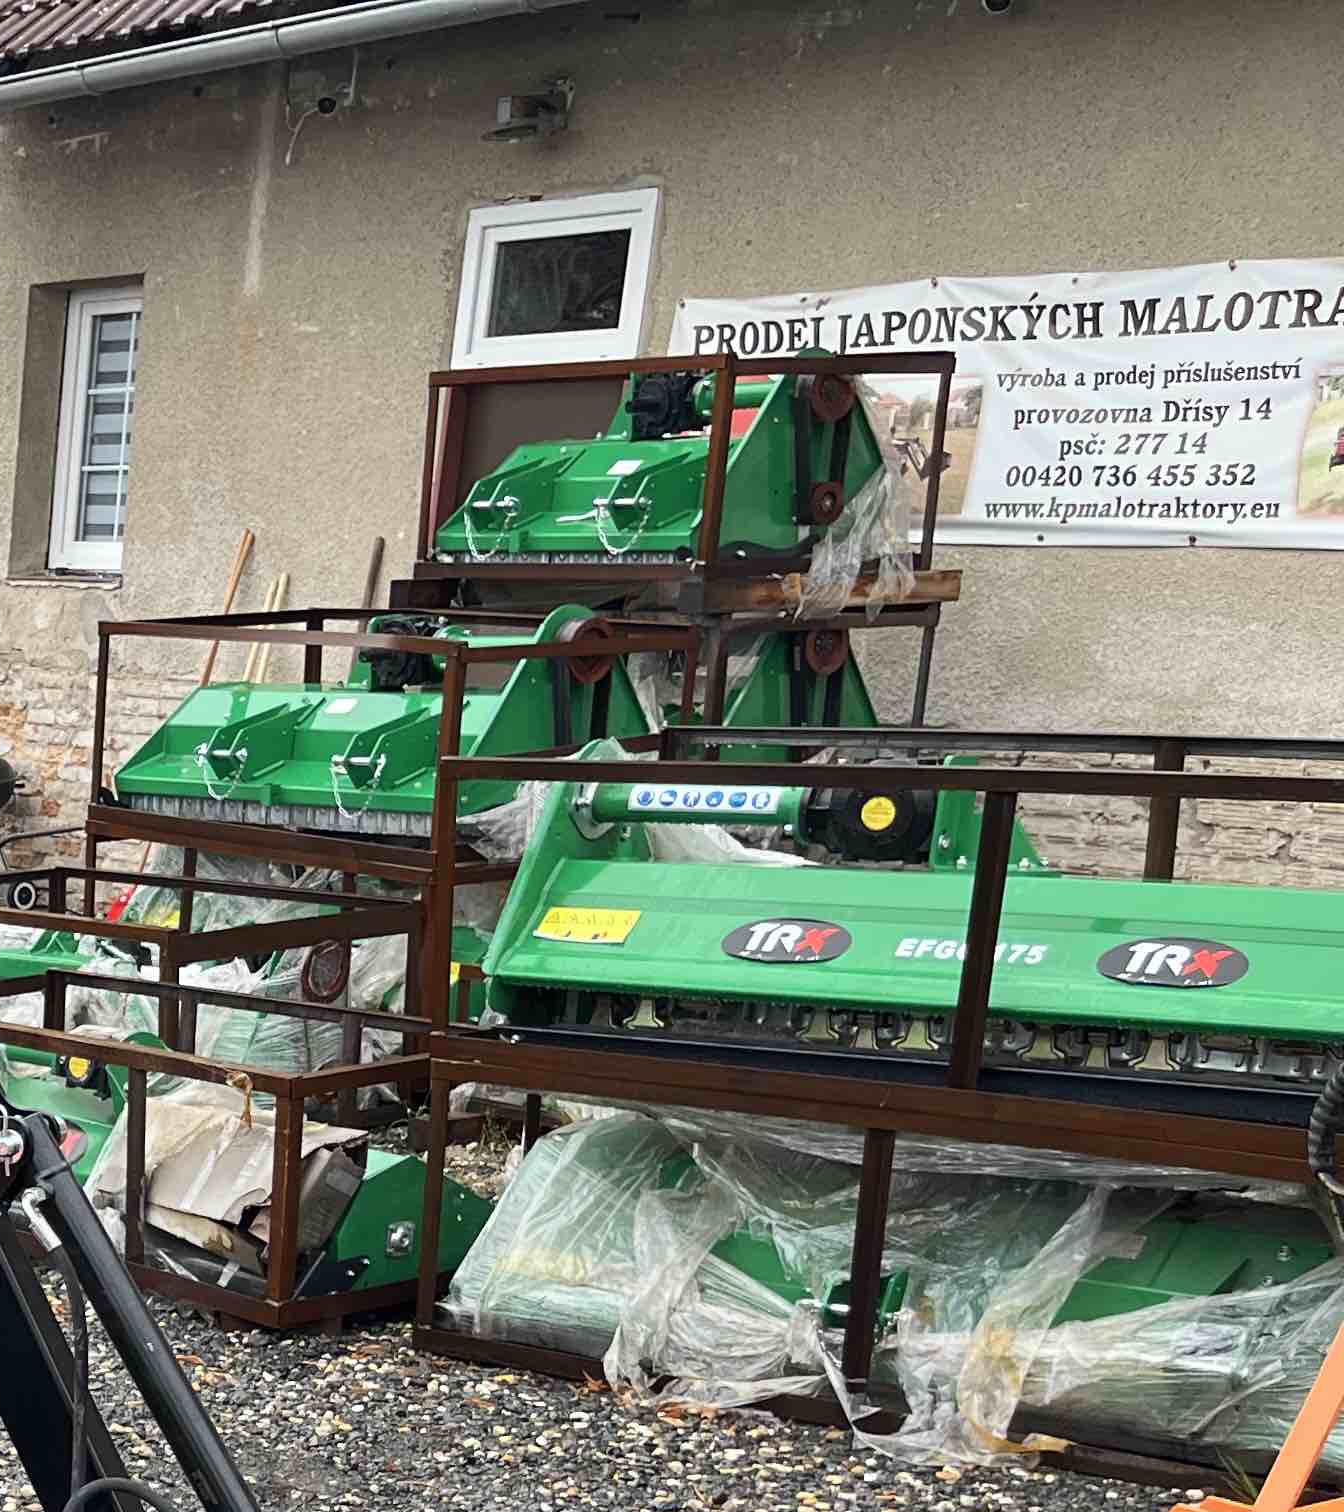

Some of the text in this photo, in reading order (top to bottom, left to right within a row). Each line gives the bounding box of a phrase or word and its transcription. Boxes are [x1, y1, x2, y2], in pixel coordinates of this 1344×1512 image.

[835, 292, 1105, 355] JAPONSKÝCH
[997, 357, 1304, 391] výroba a prodej příslušenství
[1013, 397, 1273, 430] provozovna Dřísy 14
[1058, 431, 1208, 461] psč: 277 14
[1004, 462, 1256, 488] 00420 736 455 352
[983, 496, 1281, 525] www.kpmalotraktory.eu
[744, 922, 841, 953] TRX
[1123, 941, 1236, 978] TRX
